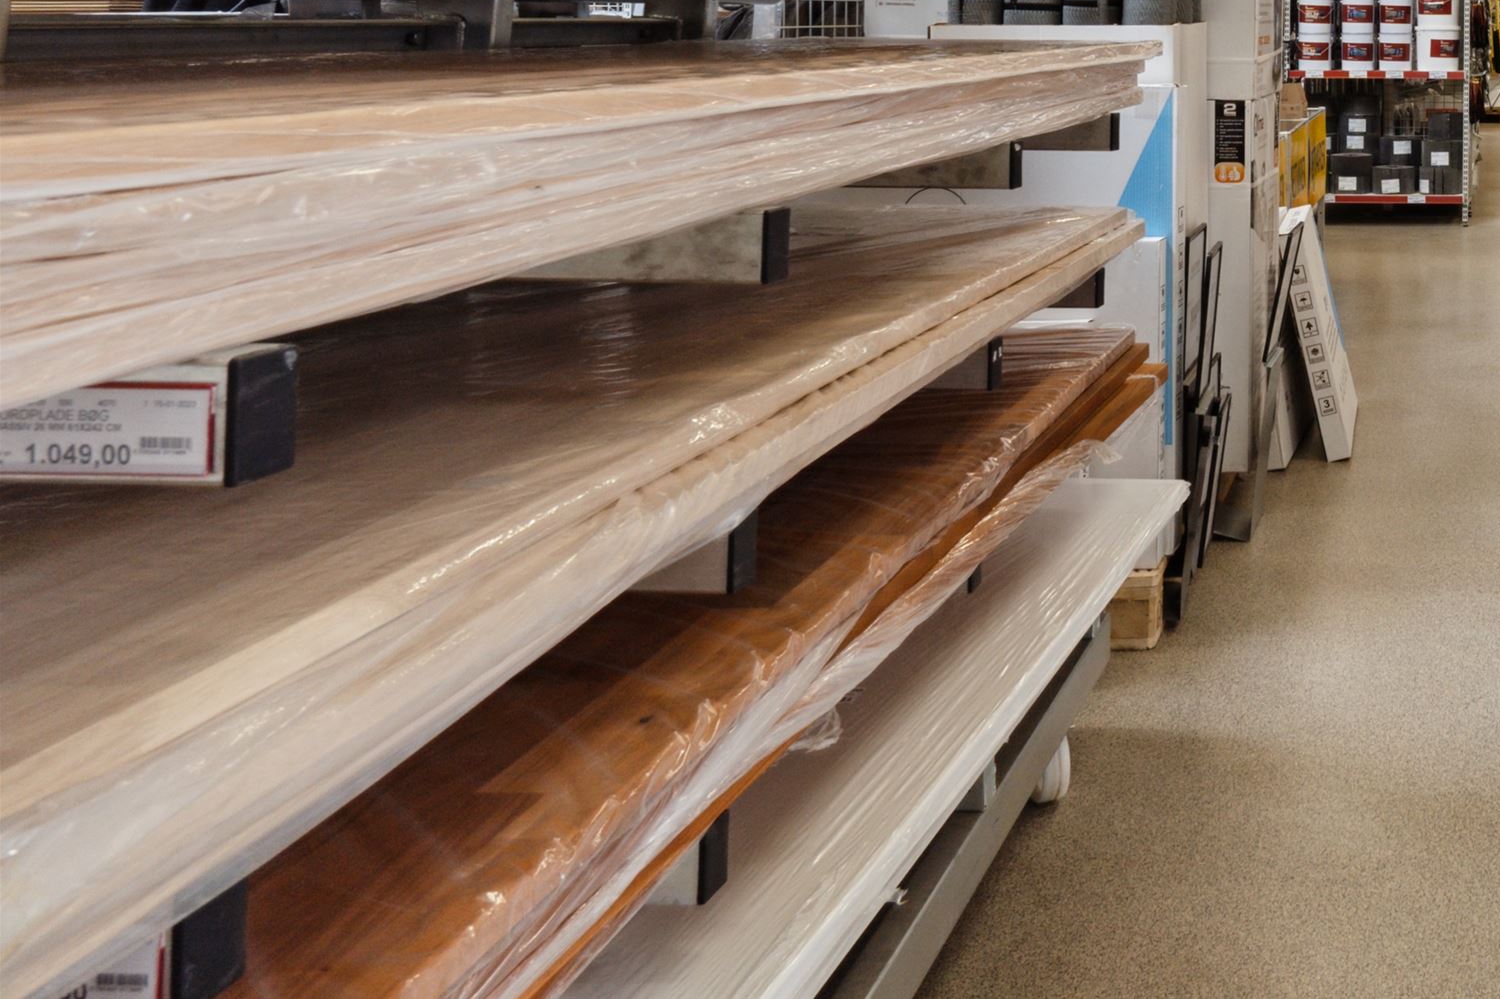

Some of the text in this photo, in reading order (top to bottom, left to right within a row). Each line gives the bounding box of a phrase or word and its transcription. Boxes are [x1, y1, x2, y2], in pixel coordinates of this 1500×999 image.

[1223, 103, 1237, 117] 2
[78, 408, 110, 422] BØG
[25, 442, 131, 468] 1.049,00
